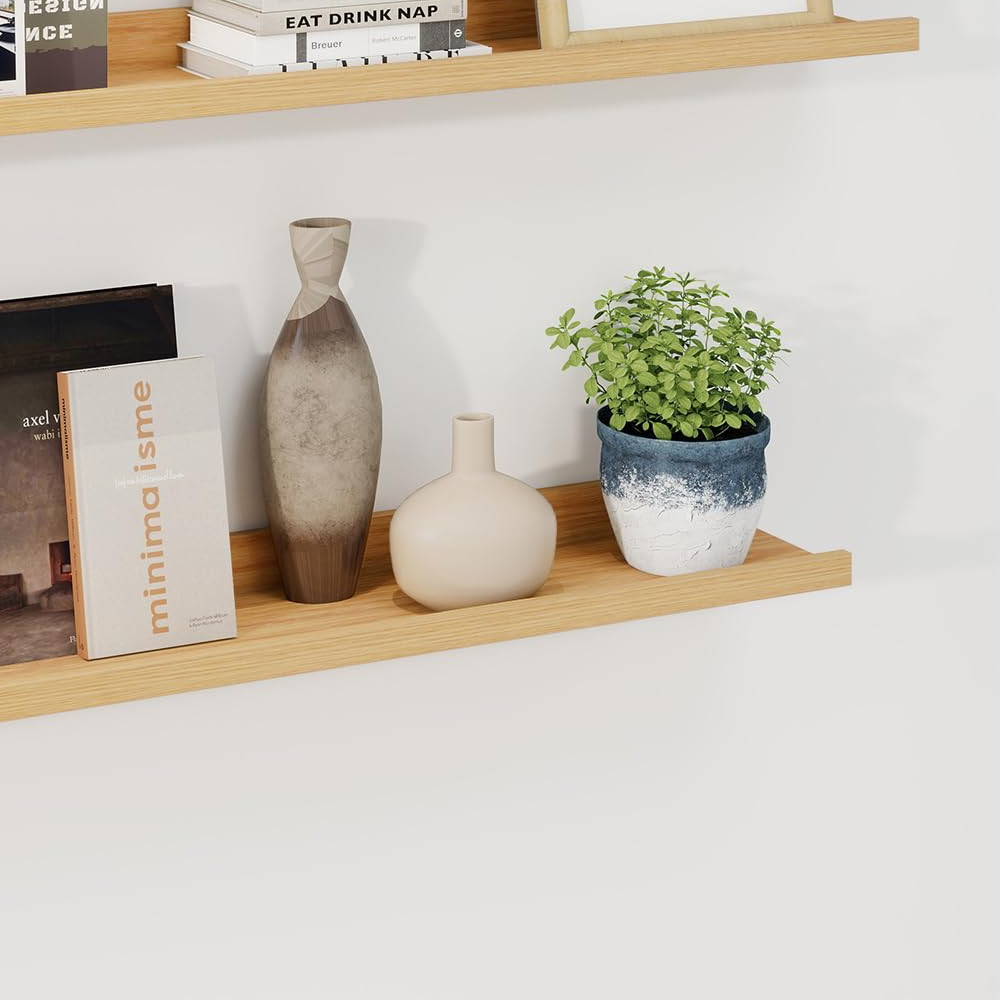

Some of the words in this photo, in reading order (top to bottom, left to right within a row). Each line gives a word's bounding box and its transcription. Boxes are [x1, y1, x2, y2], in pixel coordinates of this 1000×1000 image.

[286, 14, 322, 29] EAT
[329, 8, 391, 25] DRINK
[398, 5, 438, 20] NAP
[311, 40, 343, 50] Breuer
[22, 409, 50, 428] axel
[33, 429, 55, 441] wabi
